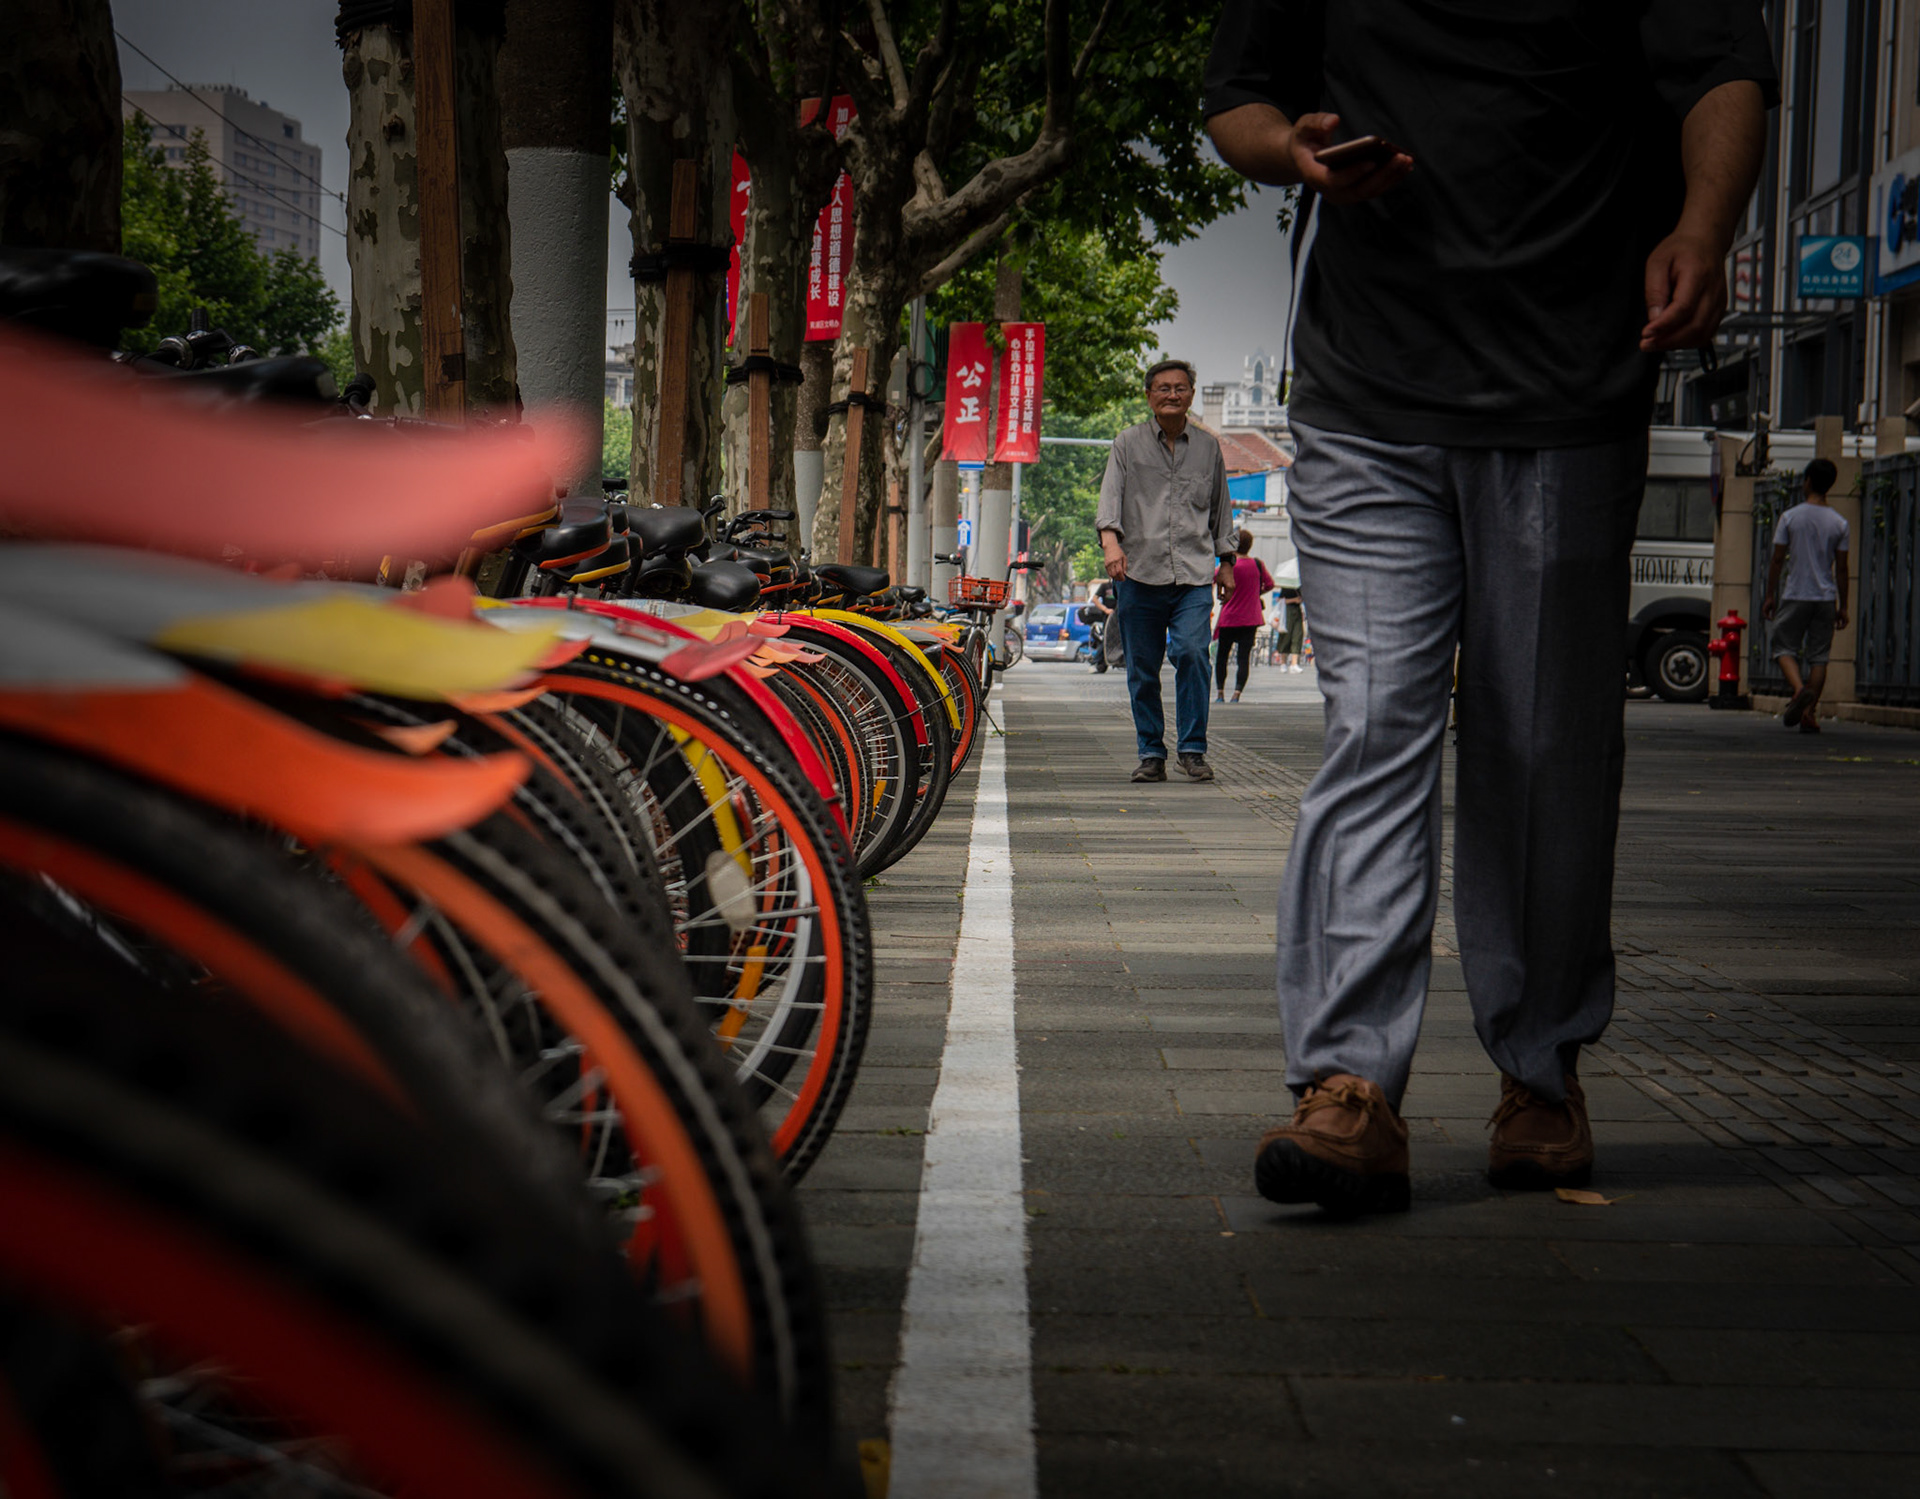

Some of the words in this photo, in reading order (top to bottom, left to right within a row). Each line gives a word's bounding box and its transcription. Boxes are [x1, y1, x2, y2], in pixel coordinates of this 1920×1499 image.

[827, 107, 849, 307] 加强年人思想道德建设
[809, 210, 823, 300] 人健康成长
[955, 360, 985, 424] 公正
[1634, 557, 1679, 584] HOME
[1684, 558, 1695, 584] &
[1699, 558, 1714, 585] G
